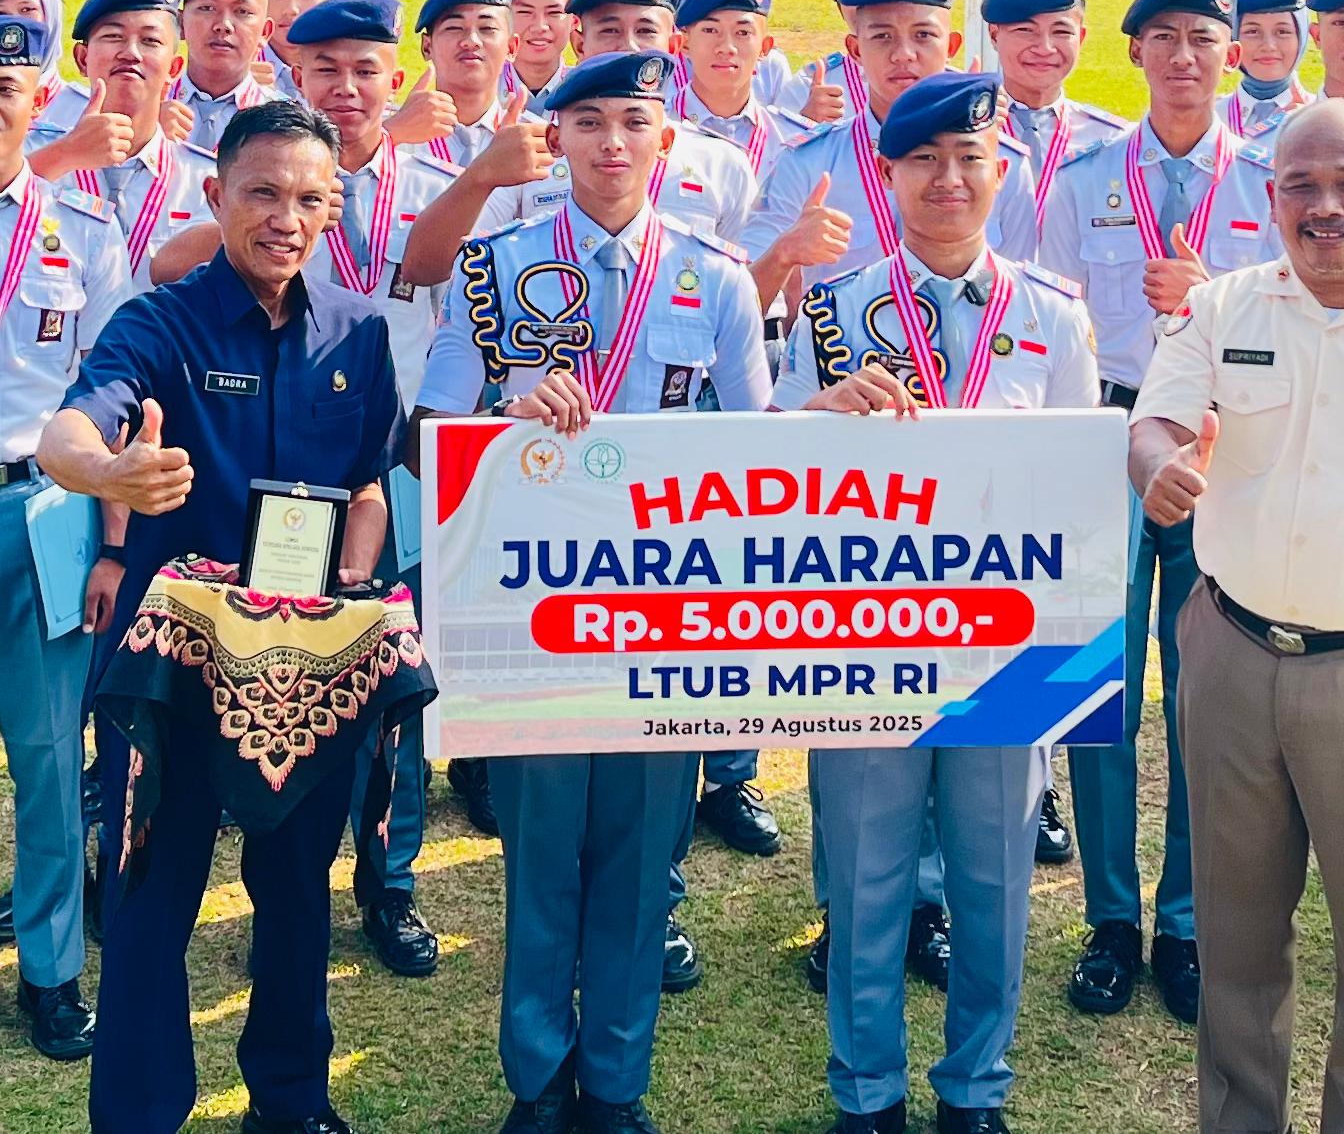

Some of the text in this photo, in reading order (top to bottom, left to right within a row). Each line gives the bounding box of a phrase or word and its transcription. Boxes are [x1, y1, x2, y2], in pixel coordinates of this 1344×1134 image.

[629, 467, 938, 530] HADIAH
[498, 533, 1063, 590] JUARA HARAPAN
[574, 598, 994, 651] Rp. 5.000.000,-
[628, 662, 938, 699] LTUB MPR RI
[643, 715, 923, 738] Jakarta, 29 Agustus 2025
